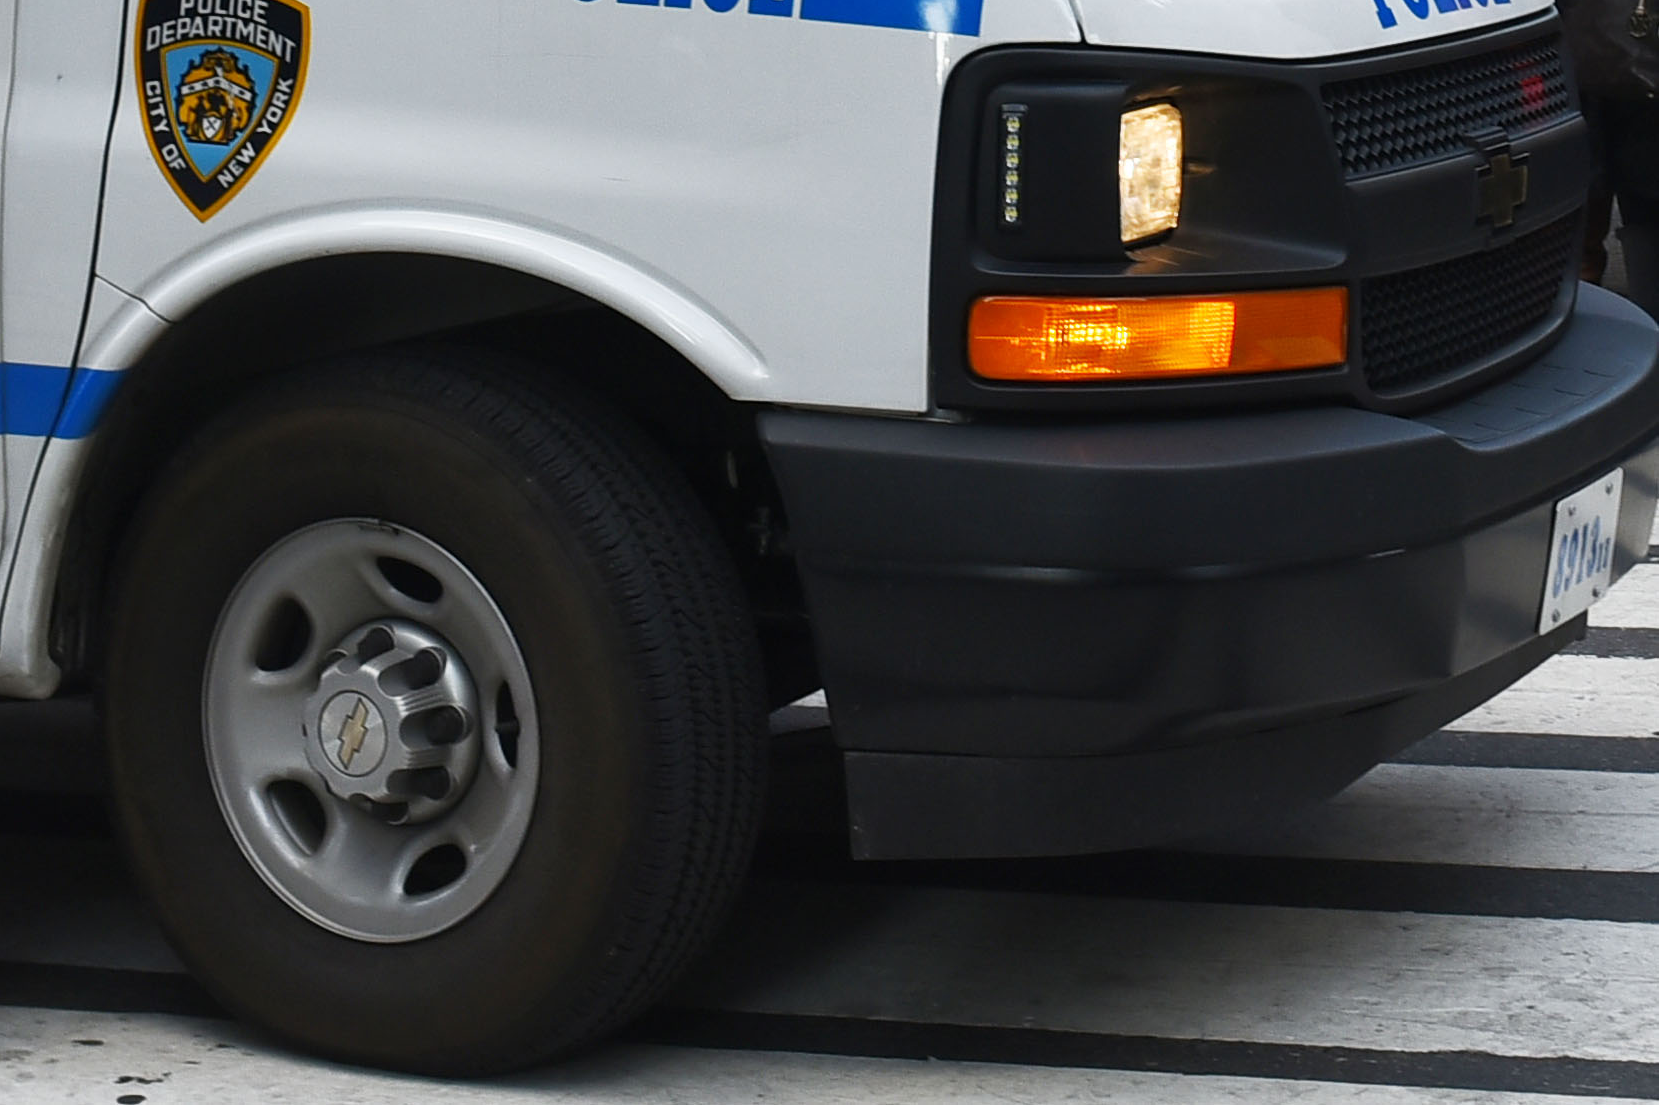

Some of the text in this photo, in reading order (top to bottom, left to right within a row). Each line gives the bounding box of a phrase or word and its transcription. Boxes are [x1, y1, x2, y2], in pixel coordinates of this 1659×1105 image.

[146, 16, 297, 63] DEPARTMENT
[145, 78, 294, 188] CITY OF NEW YORK
